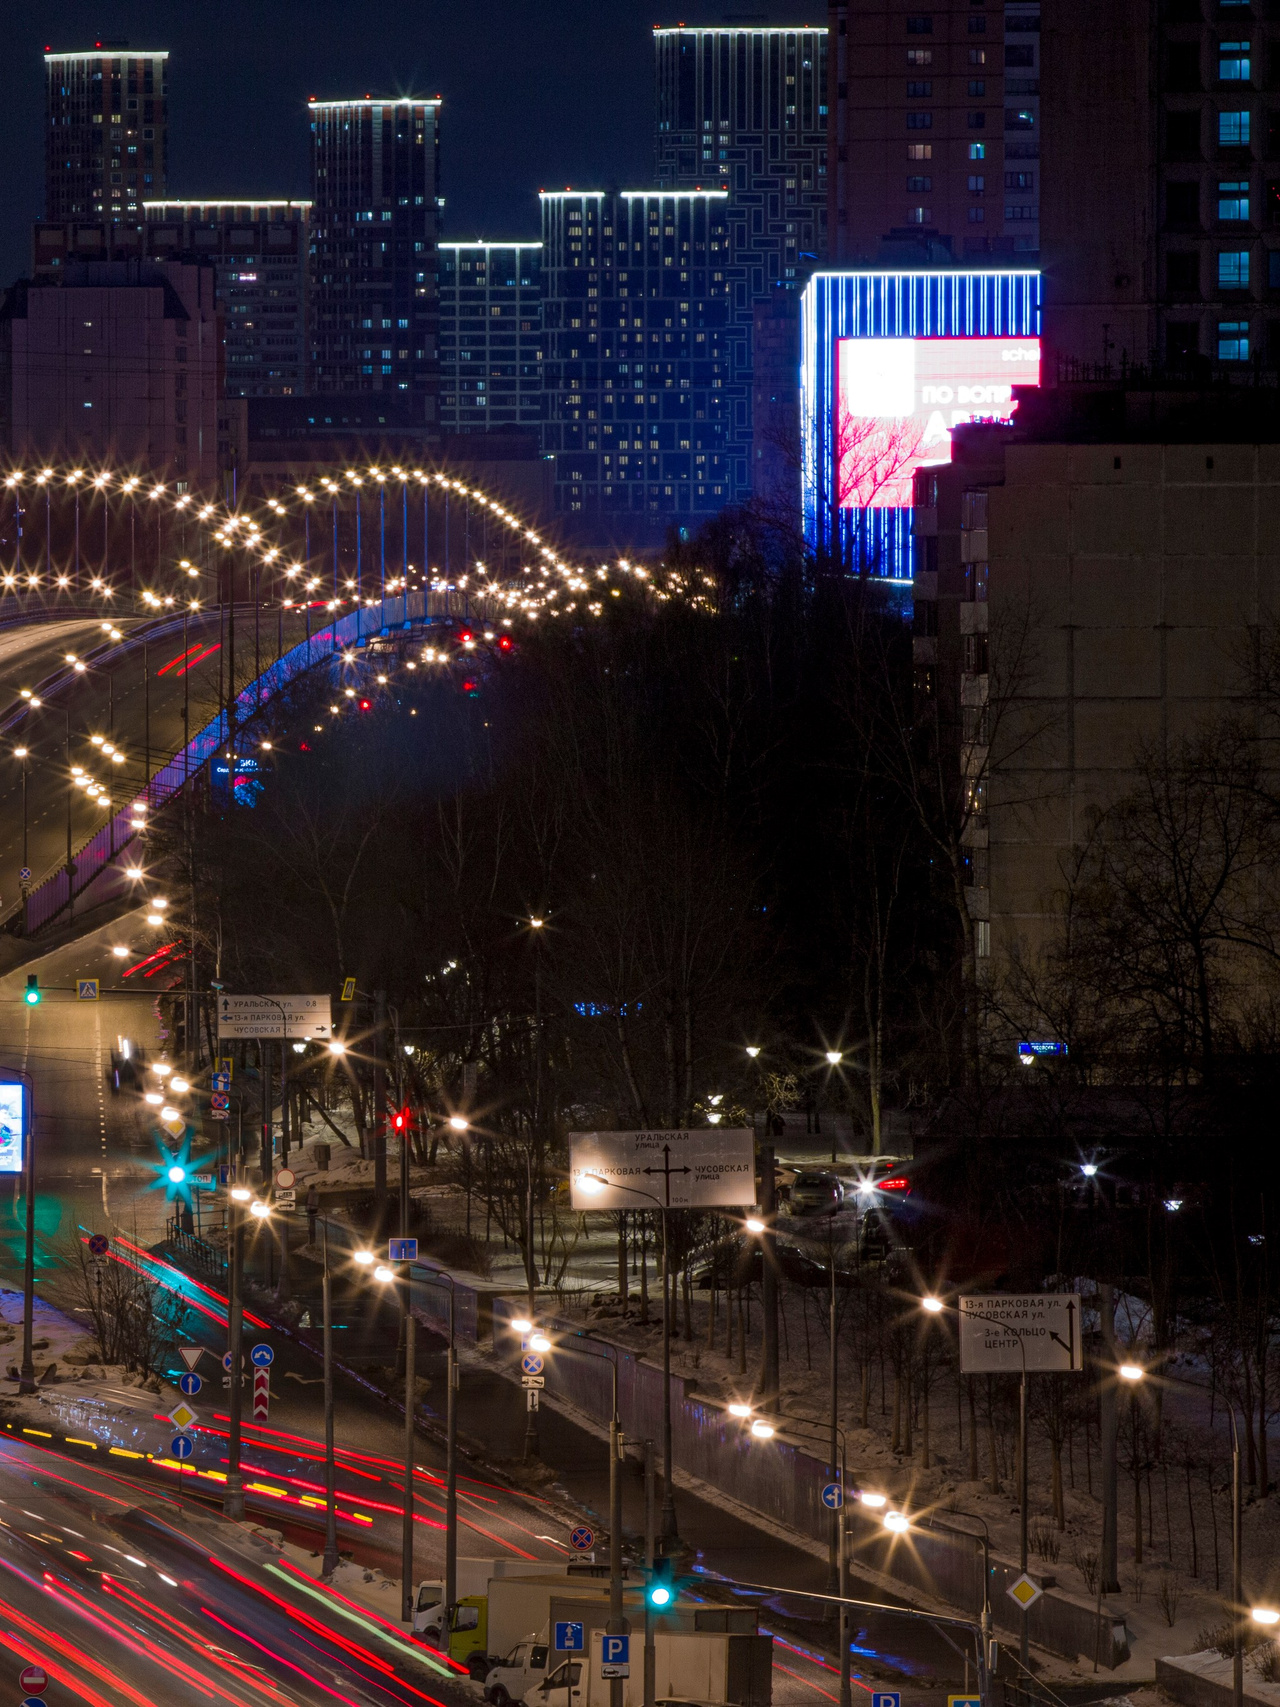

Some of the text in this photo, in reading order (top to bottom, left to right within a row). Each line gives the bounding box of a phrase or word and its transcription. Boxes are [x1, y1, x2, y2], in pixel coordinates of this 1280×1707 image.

[233, 1000, 280, 1008] УРАЛЬСКАЯ
[634, 1132, 690, 1142] УРАЛЬСКАЯ
[635, 1142, 660, 1150] улица
[591, 1167, 641, 1176] ПАРКОВАЯ
[694, 1164, 749, 1173] ЧУСОВСКАЯ
[695, 1173, 720, 1182] улица
[986, 1299, 1044, 1308] ПАРКОВАЯ
[1047, 1300, 1062, 1309] ул.
[965, 1310, 1045, 1320] ЧУСОВСКАЯ ул.
[985, 1327, 1046, 1337] 3-е КОЛЬЦО
[985, 1340, 1019, 1349] ЦЕНТР
